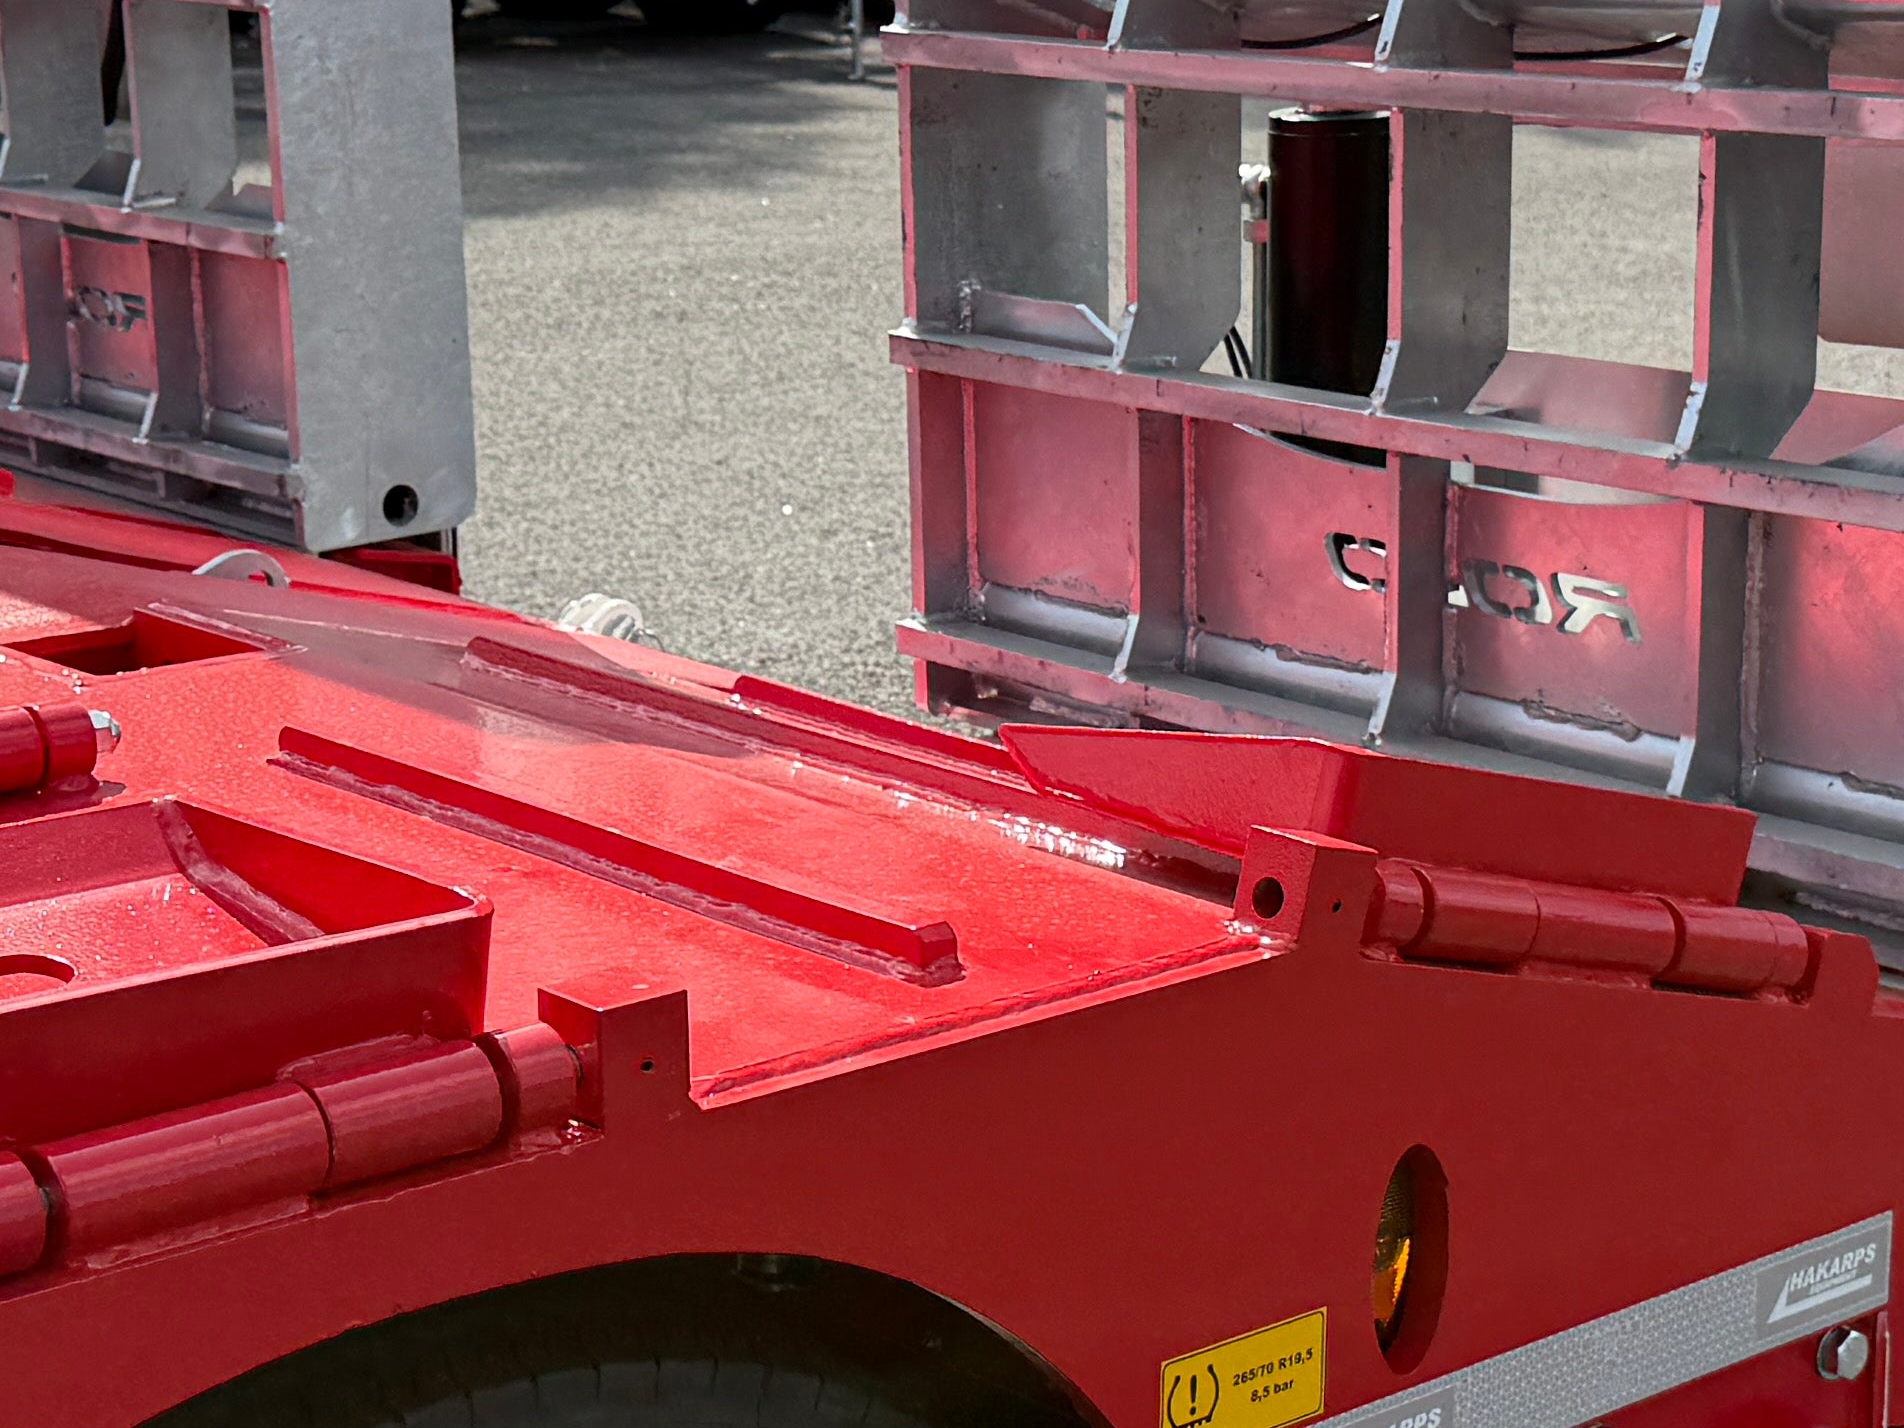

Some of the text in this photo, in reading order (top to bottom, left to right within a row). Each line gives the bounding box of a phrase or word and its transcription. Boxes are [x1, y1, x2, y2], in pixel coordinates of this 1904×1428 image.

[1790, 1243, 1876, 1292] HAKARPS
[1233, 1347, 1313, 1387] 265/70 R19,5
[1250, 1379, 1295, 1403] 8,5 bar
